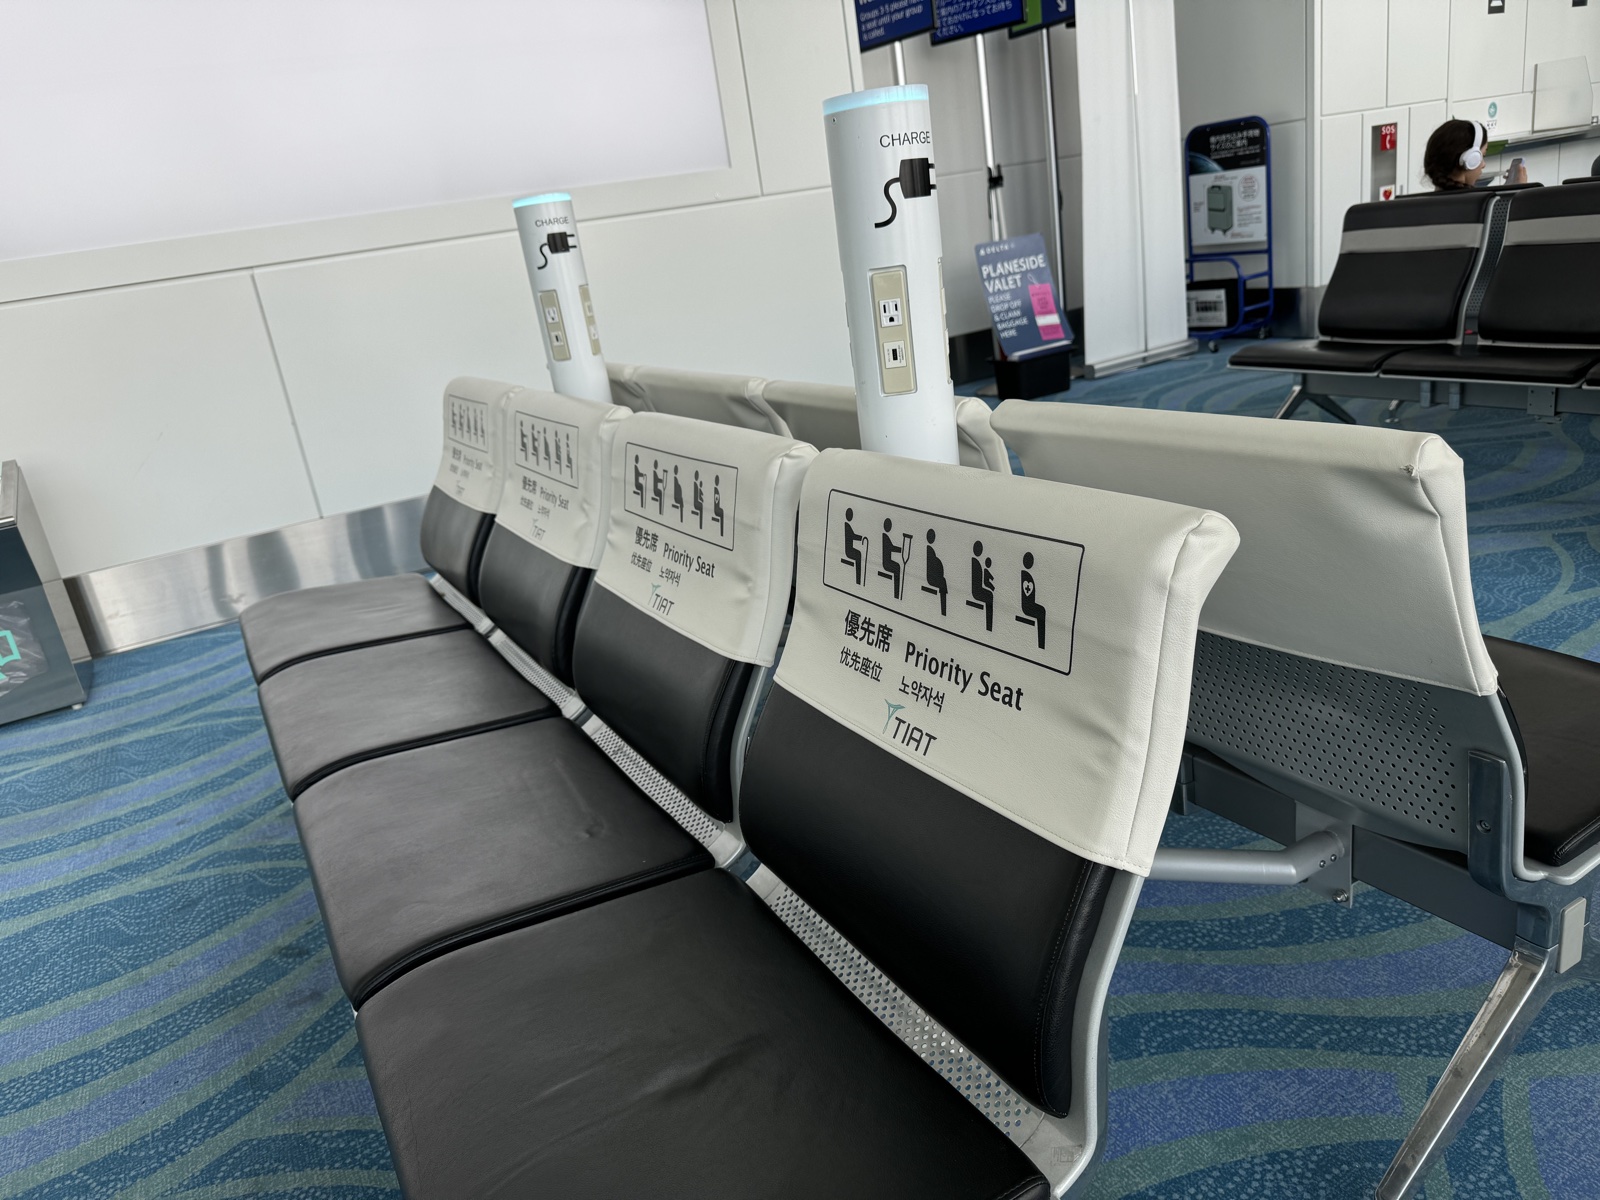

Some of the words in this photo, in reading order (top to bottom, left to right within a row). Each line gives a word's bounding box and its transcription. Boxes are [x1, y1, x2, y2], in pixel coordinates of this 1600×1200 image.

[891, 11, 905, 24] your
[905, 5, 924, 19] group
[879, 130, 931, 148] CHARGE
[1381, 124, 1396, 135] SOS
[535, 216, 570, 228] CHARGE
[981, 254, 1047, 279] PLANESIDE
[984, 273, 1022, 293] VALET
[988, 292, 1011, 304] PLEASE
[991, 302, 1009, 313] DROP
[1010, 299, 1022, 309] OFF
[997, 316, 1029, 330] BAGGAGE
[1000, 309, 1022, 321] CLAIM
[1000, 328, 1018, 339] HERE
[539, 486, 558, 508] Priority
[558, 494, 569, 511] Seat
[635, 526, 659, 553] 優先席
[662, 544, 694, 572] Priority
[696, 556, 716, 578] Seat
[631, 553, 652, 574] 优先座位
[659, 566, 681, 588] 노약자석
[651, 592, 675, 616] TIAT
[844, 609, 893, 653] 優先席
[905, 641, 974, 693] Priority
[978, 671, 1024, 712] Seat
[840, 646, 883, 682] 优先座位
[899, 676, 946, 713] 노약자석
[892, 716, 938, 756] TIAT
